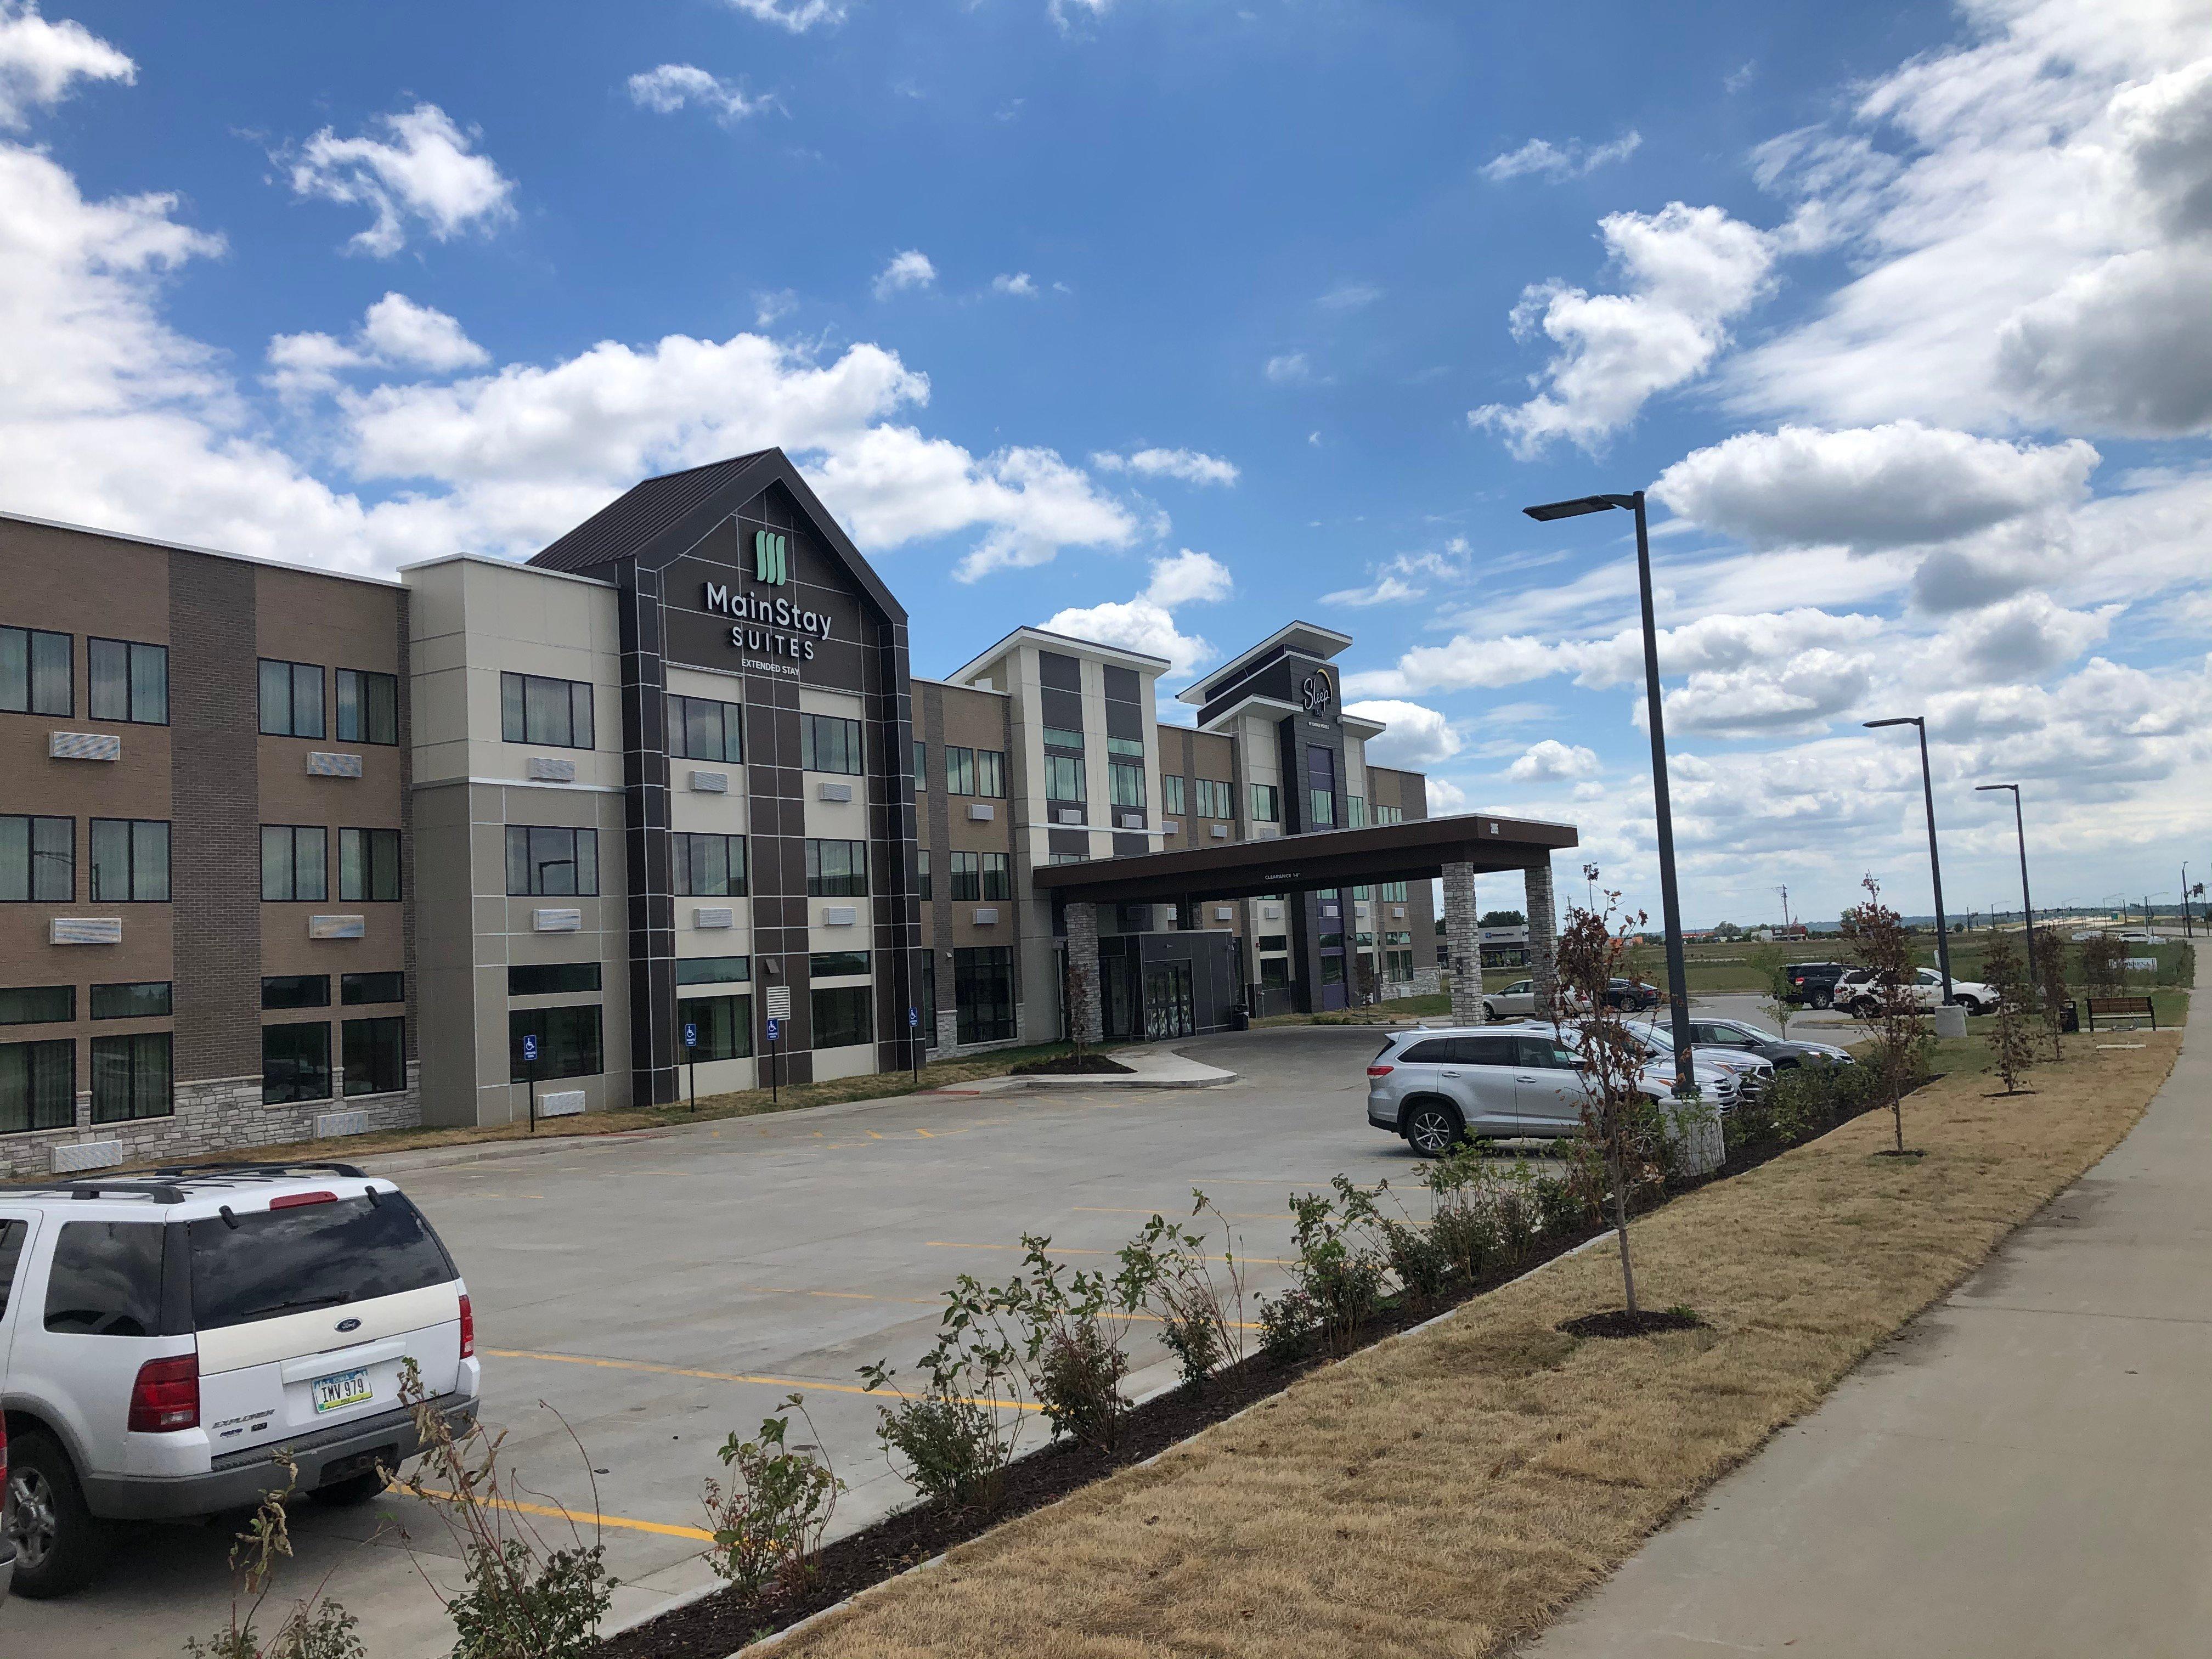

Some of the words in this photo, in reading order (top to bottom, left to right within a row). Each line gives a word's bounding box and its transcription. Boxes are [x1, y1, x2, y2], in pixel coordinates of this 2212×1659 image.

[707, 582, 831, 640] MainStay
[732, 627, 814, 659] SUITES
[742, 658, 781, 673] EXTENDED
[782, 665, 799, 675] STAY
[1304, 678, 1330, 712] Sleep
[341, 1320, 356, 1329] Ford
[345, 1378, 364, 1397] 979
